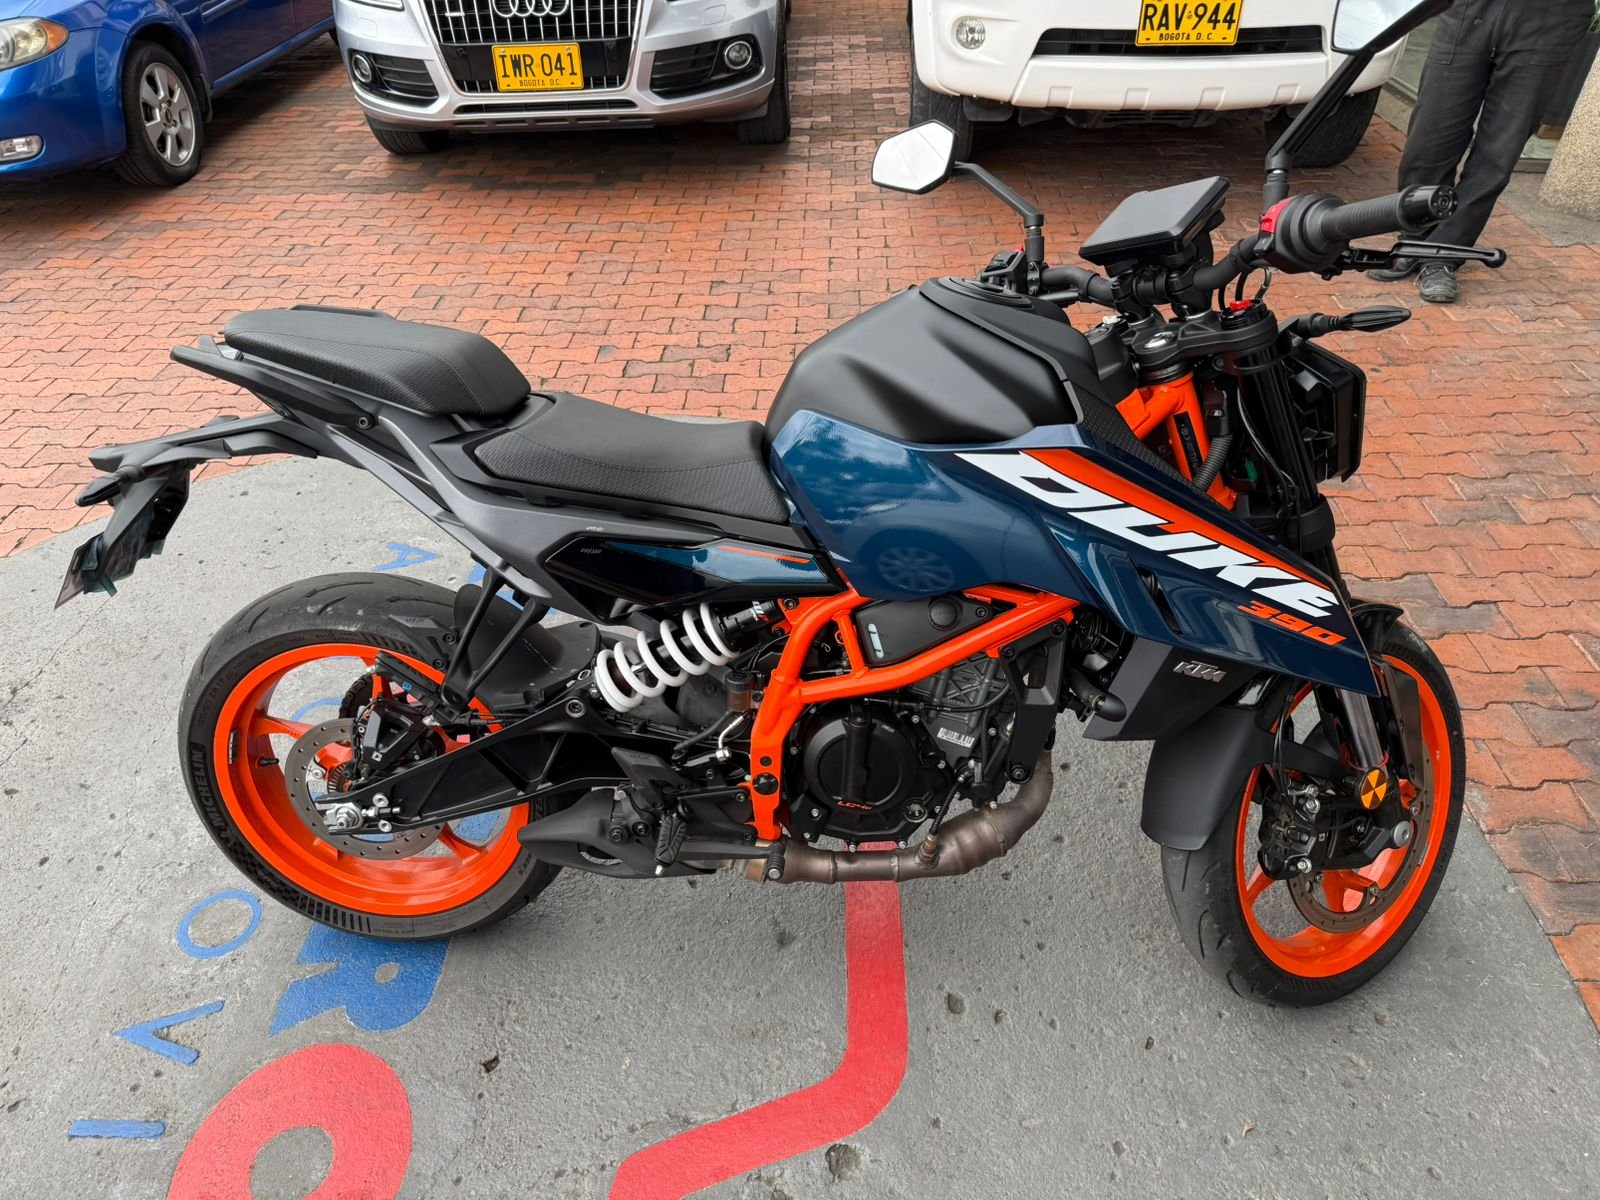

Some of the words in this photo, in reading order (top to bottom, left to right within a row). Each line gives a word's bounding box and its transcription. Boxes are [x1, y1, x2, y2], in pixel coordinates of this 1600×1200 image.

[1142, 3, 1187, 31] RAV
[1192, 3, 1235, 30] 944
[1159, 33, 1190, 41] BOGOTA
[499, 54, 536, 78] IWR
[540, 52, 577, 76] 041
[519, 79, 546, 87] BOGOTA
[954, 453, 1340, 618] DUKE
[1237, 601, 1348, 645] 390
[1173, 660, 1226, 683] KTM
[191, 748, 226, 830] MICHELIN
